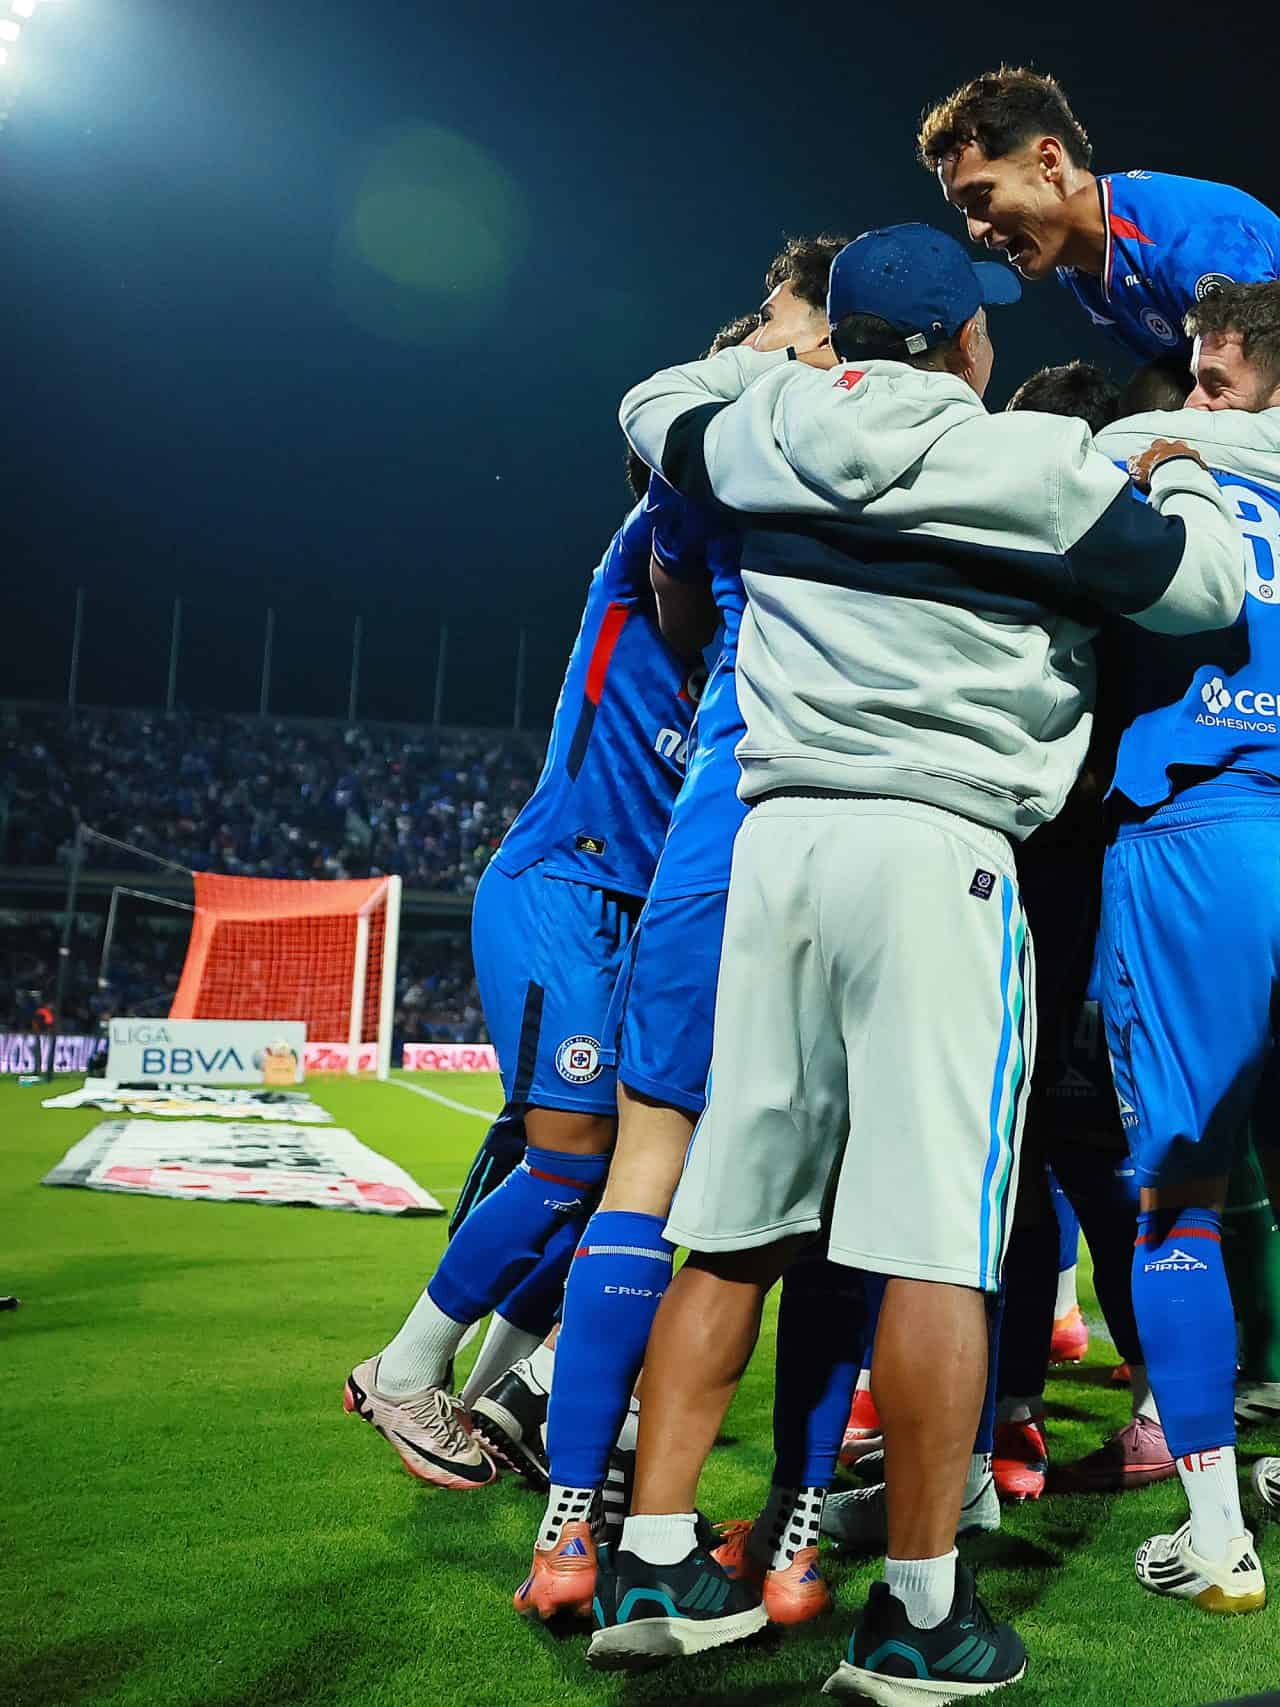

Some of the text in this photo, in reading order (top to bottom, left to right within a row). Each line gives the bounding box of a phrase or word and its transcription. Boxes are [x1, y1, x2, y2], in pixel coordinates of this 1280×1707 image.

[1195, 713, 1277, 734] ADHESIVOS
[114, 1026, 171, 1045] LIGA
[143, 1048, 244, 1075] BBVA
[1144, 1261, 1208, 1273] PIRMA
